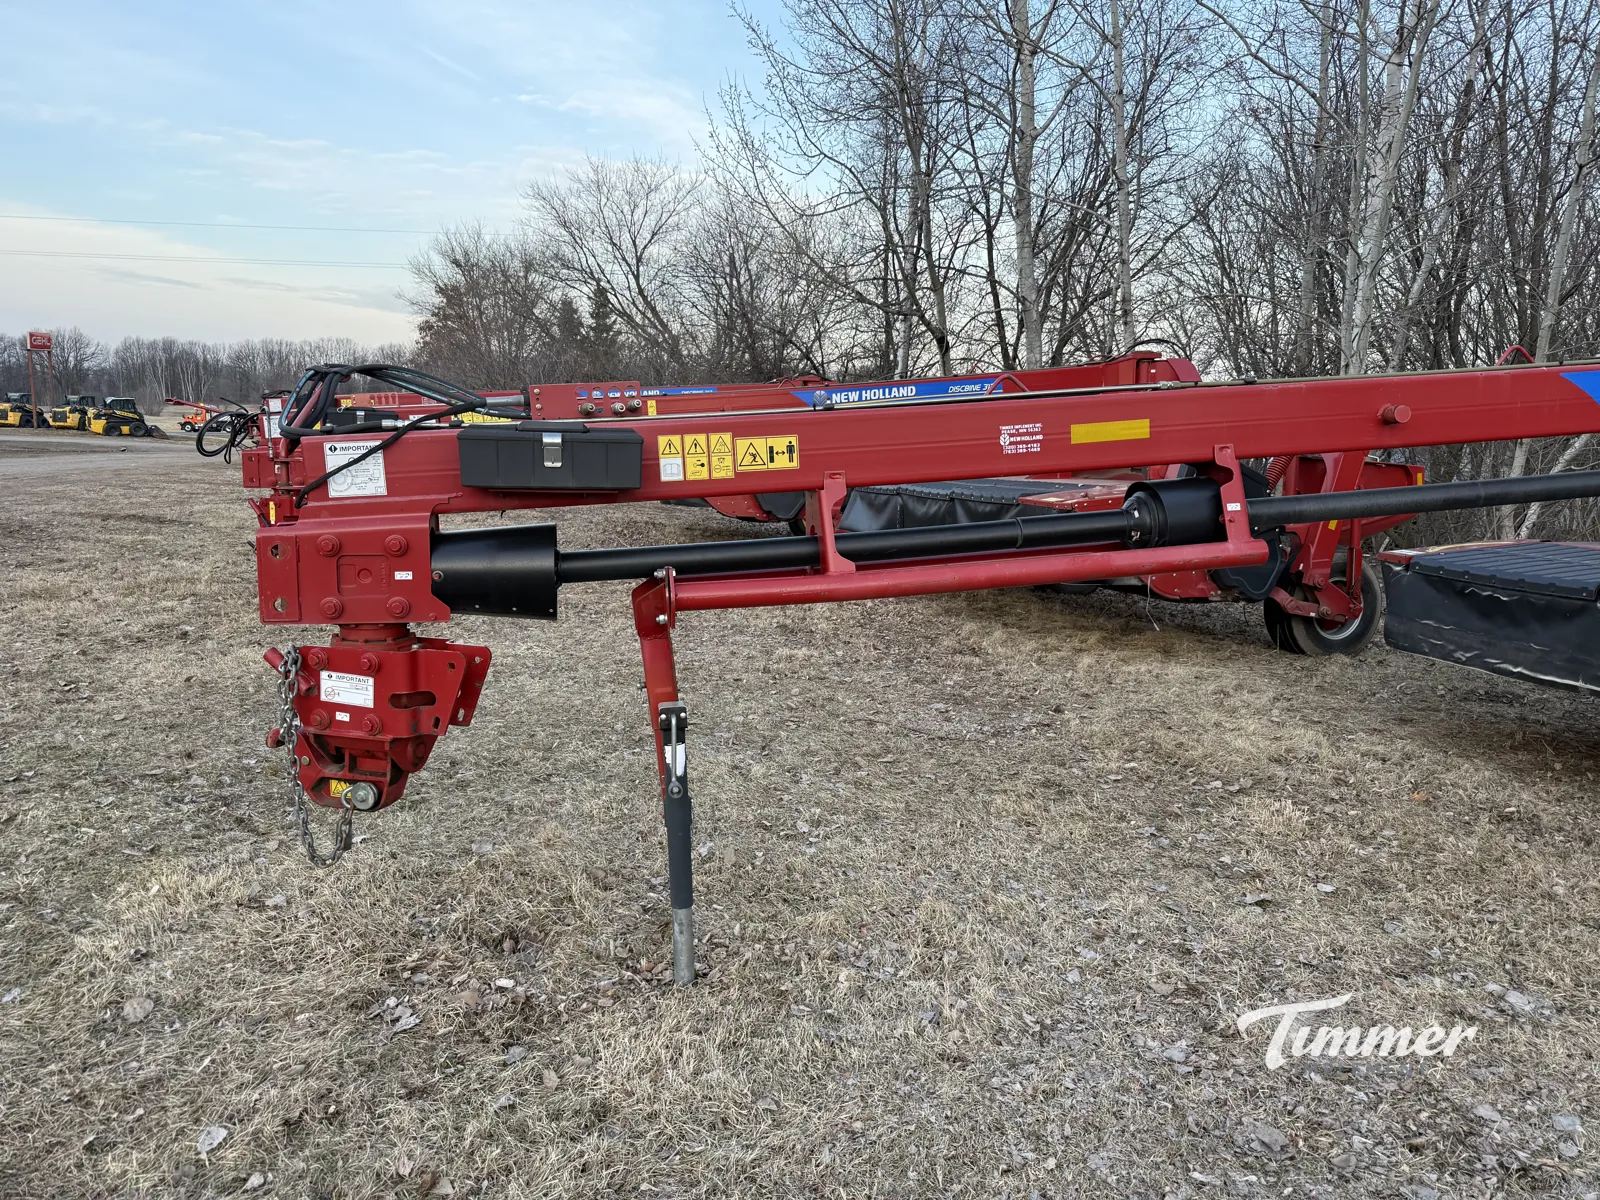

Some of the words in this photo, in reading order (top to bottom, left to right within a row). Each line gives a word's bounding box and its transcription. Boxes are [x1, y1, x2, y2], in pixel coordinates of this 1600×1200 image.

[948, 385, 981, 393] DISCBINE
[832, 391, 859, 404] NEW
[862, 386, 916, 400] HOLLAND
[335, 675, 370, 683] IMPORTANT
